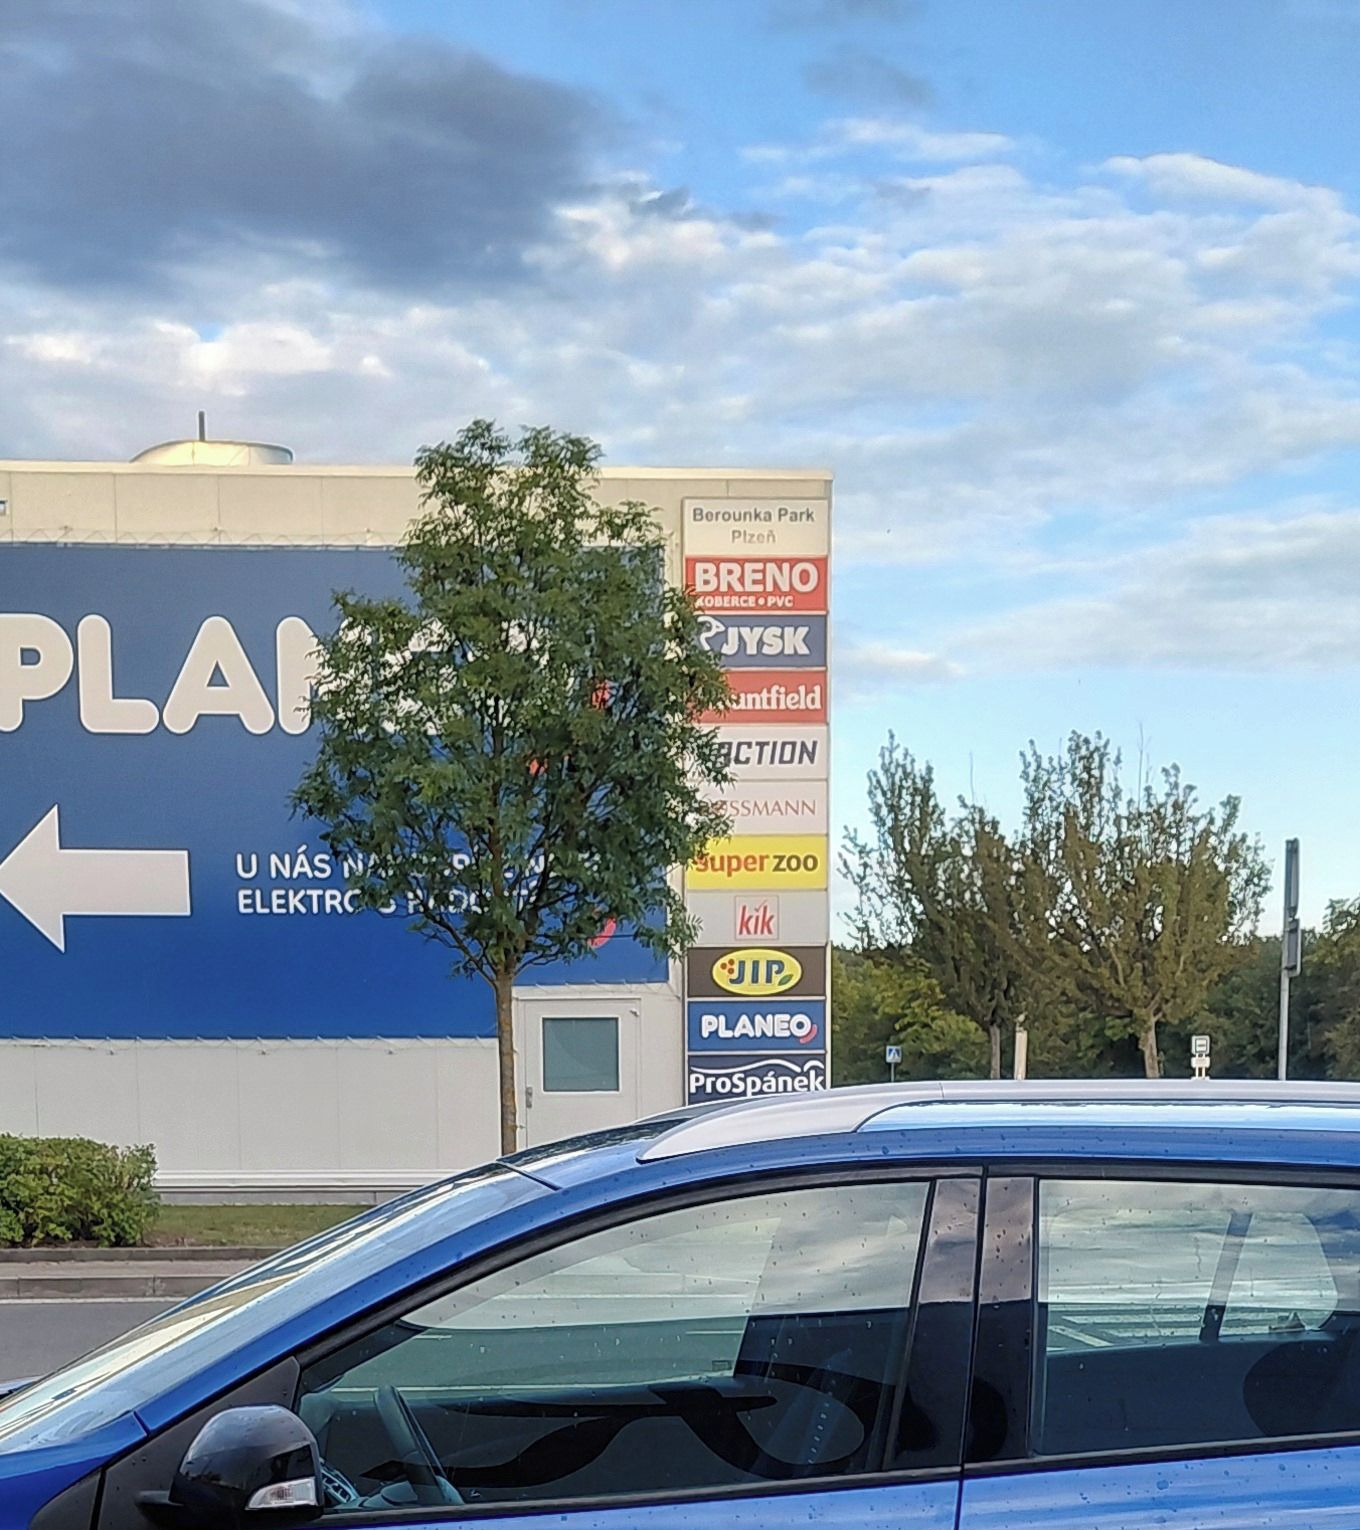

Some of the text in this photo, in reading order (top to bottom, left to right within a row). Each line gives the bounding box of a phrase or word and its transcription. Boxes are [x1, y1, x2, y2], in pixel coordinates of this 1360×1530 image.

[692, 507, 815, 522] Berounka Park
[731, 529, 776, 544] Plzeň
[695, 561, 819, 593] BRENO
[767, 595, 794, 607] PVC
[721, 626, 810, 655] JYSK
[708, 685, 822, 710] untfield
[704, 799, 816, 816] SSMANN
[236, 853, 258, 879] U
[269, 844, 332, 879] NÁS
[738, 902, 776, 936] kik
[729, 959, 785, 985] JIP
[700, 1013, 813, 1039] PLANEO
[690, 1069, 825, 1097] ProSpánek
